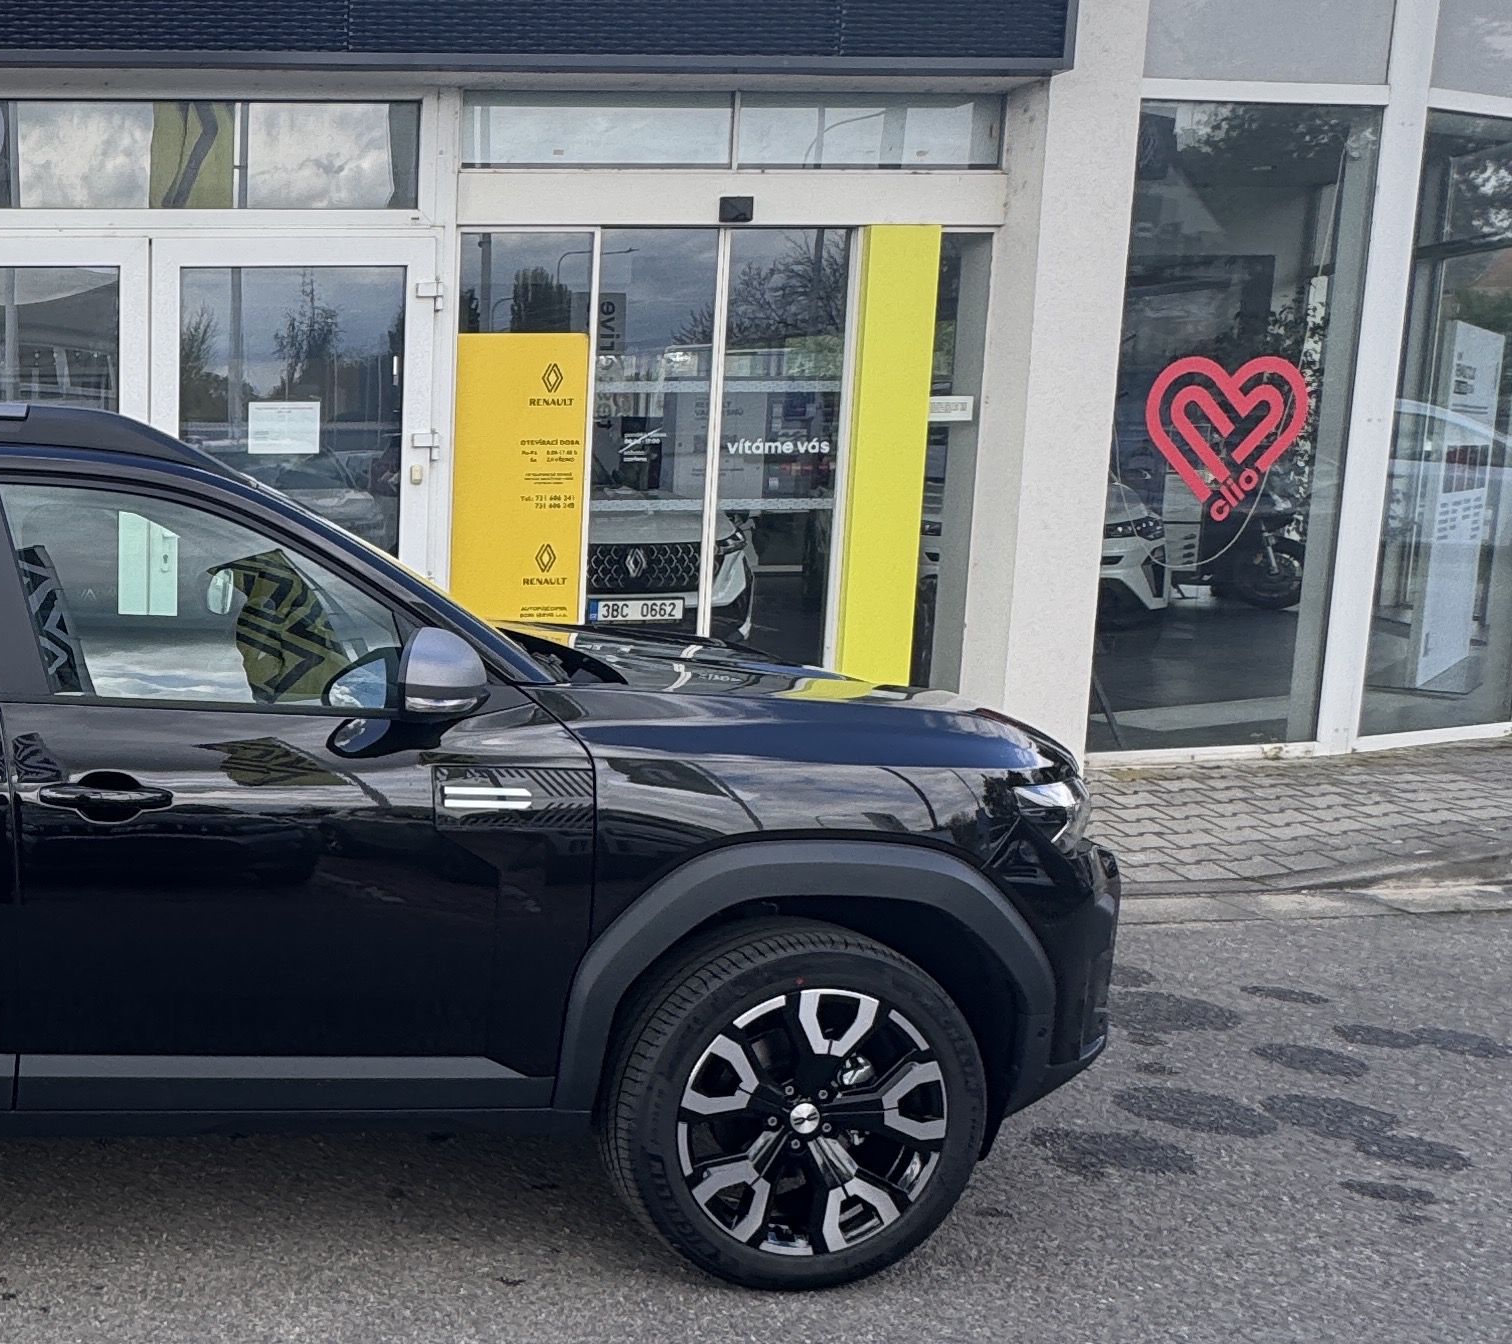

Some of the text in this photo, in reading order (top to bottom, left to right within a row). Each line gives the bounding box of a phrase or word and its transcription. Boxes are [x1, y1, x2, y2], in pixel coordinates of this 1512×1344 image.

[529, 398, 574, 406] RENAULT
[727, 438, 831, 455] vítáme vás
[1210, 467, 1259, 522] clio
[522, 577, 568, 586] RENAULT
[602, 603, 629, 619] 3BC
[640, 602, 677, 618] 0662
